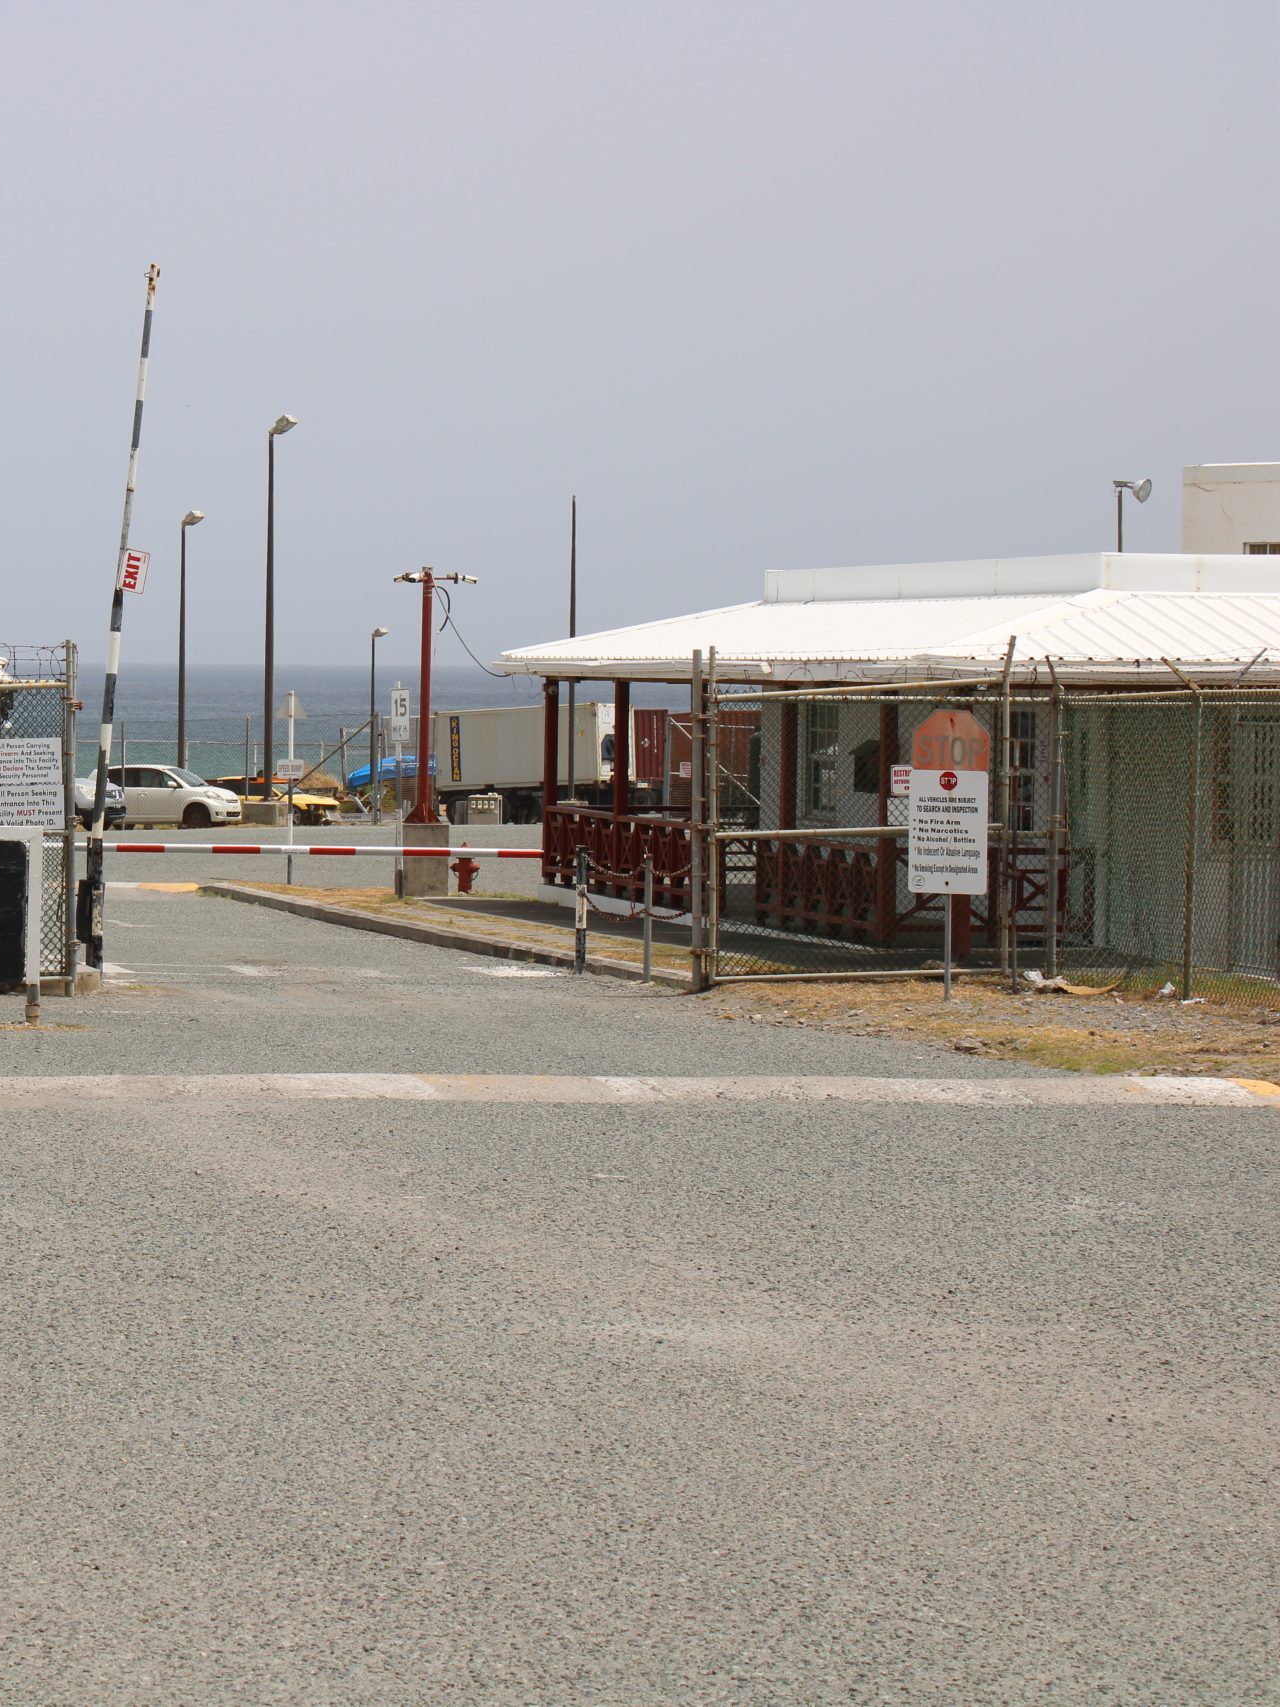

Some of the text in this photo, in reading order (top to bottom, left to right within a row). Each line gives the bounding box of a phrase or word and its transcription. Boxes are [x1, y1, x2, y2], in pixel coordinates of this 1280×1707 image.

[122, 552, 141, 590] EXIT
[394, 698, 406, 717] 15
[918, 734, 985, 768] STOP
[917, 846, 980, 860] No Indecent Or Abusive Language
